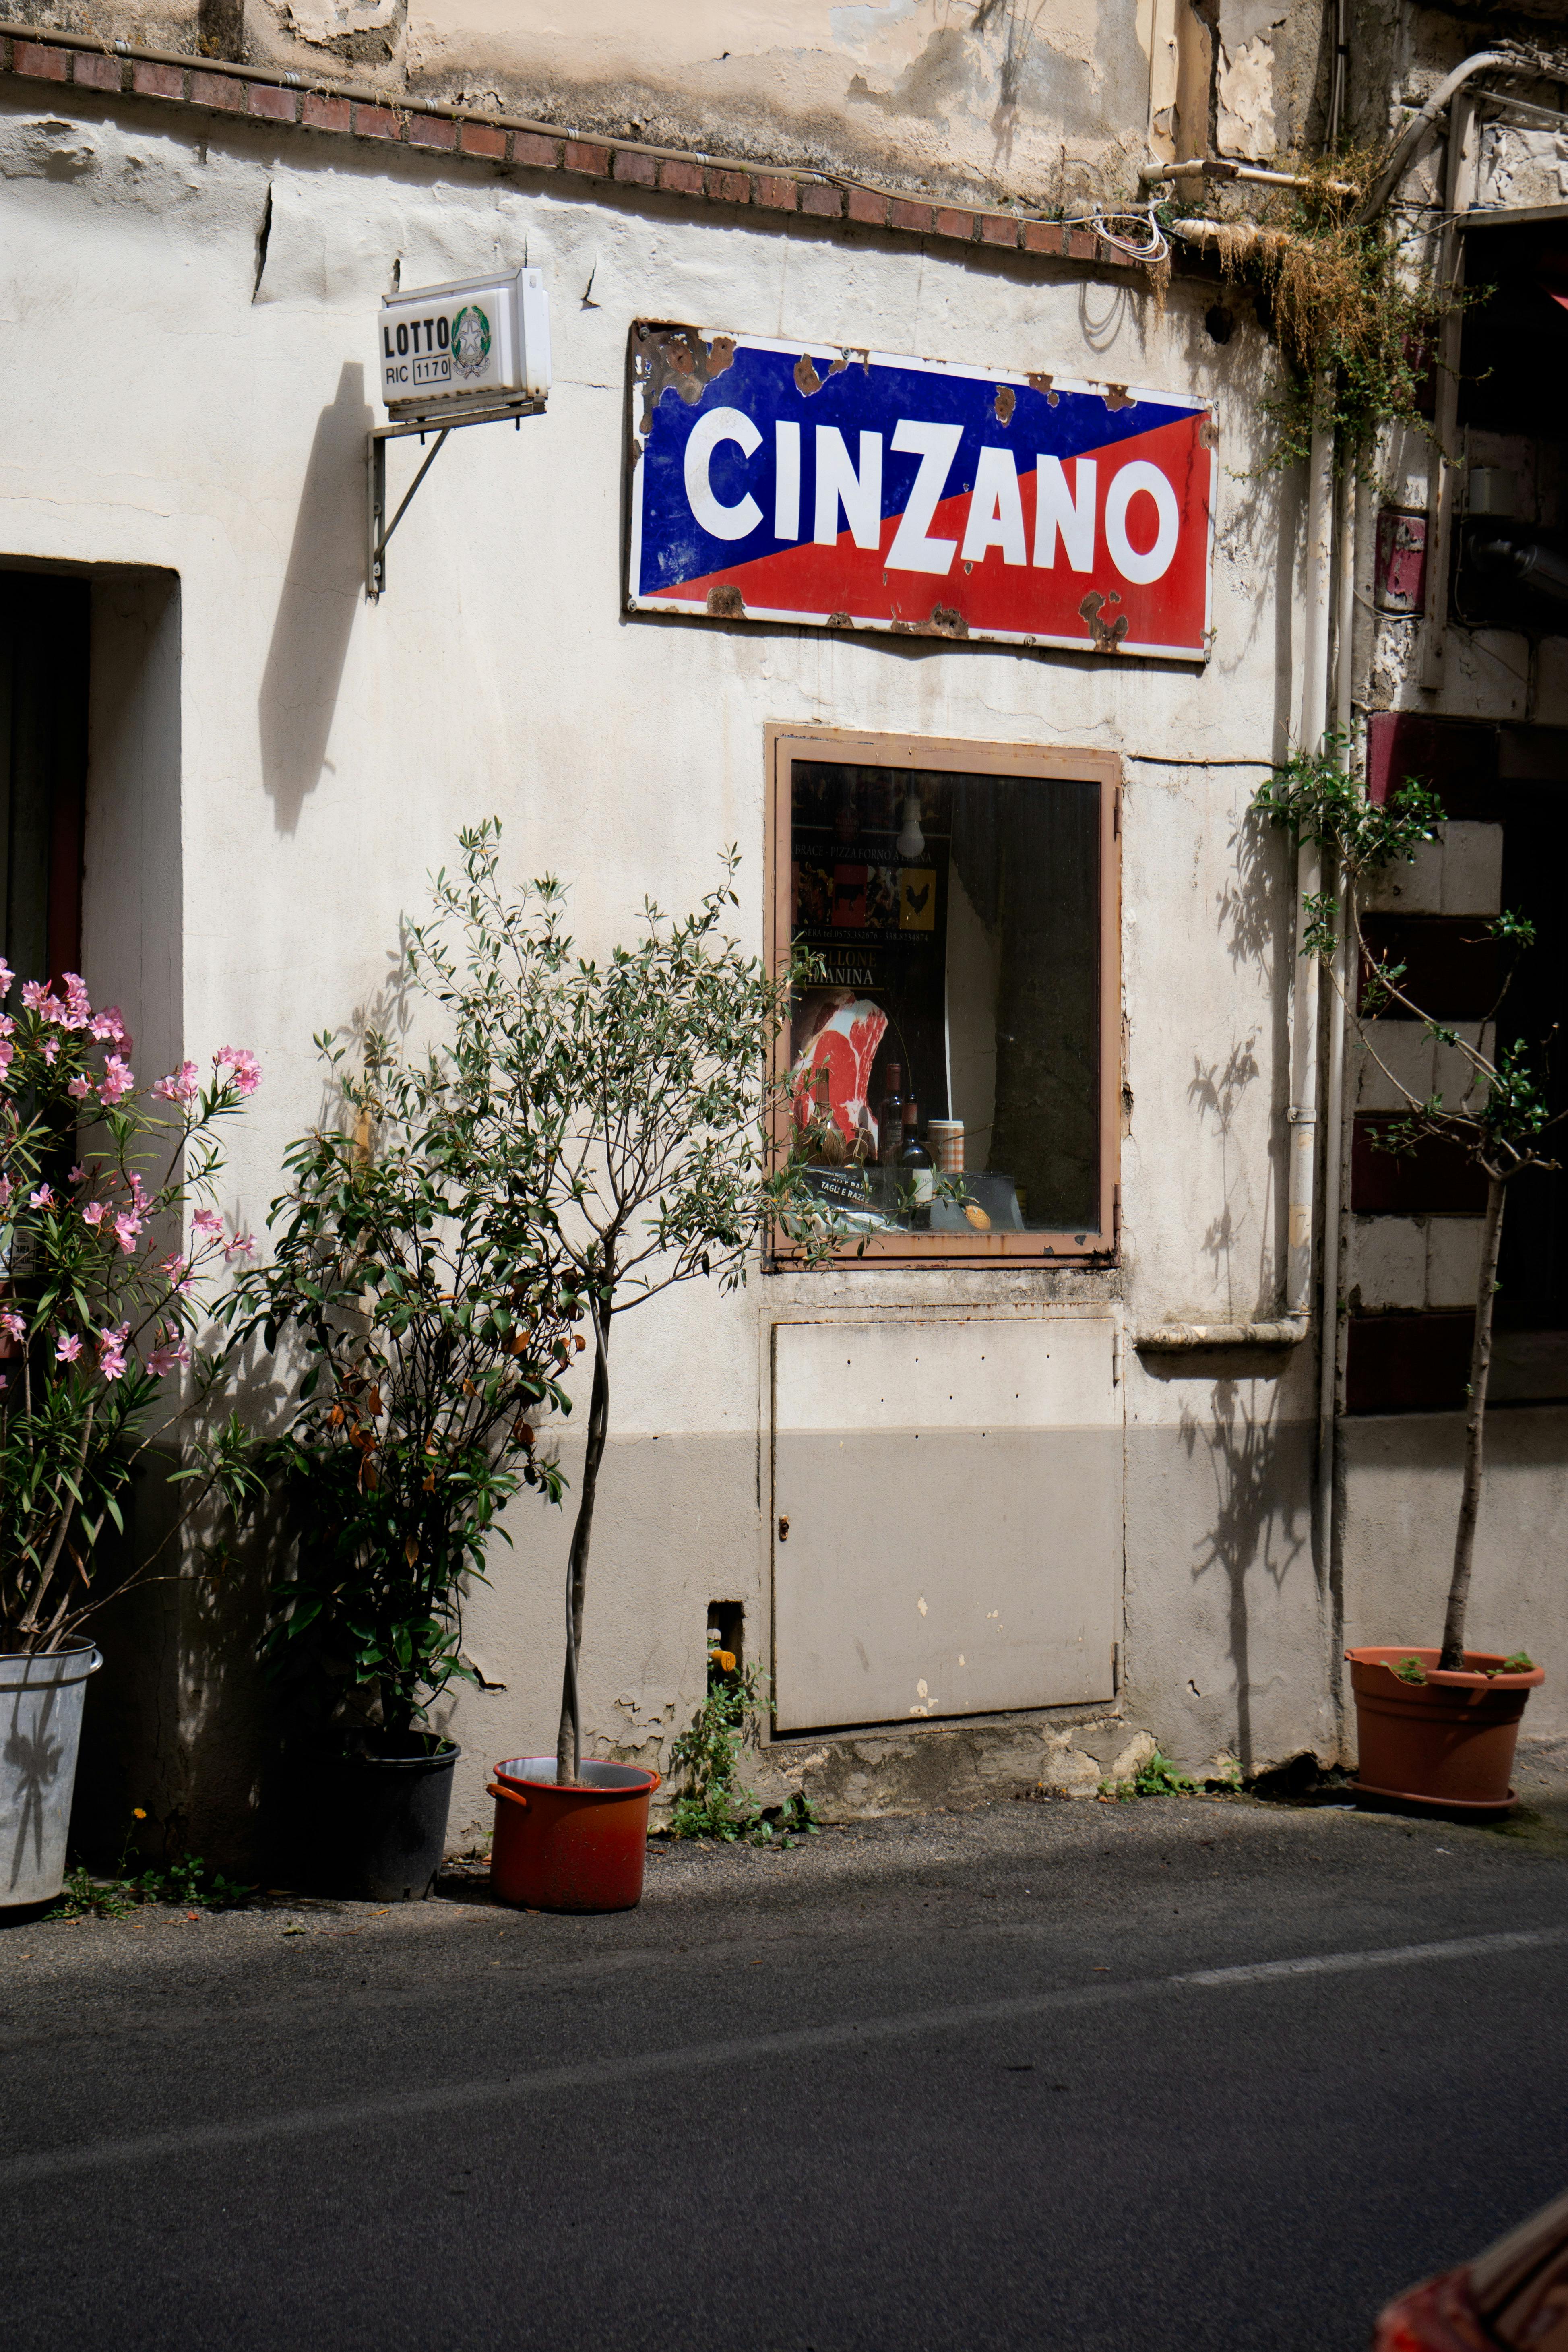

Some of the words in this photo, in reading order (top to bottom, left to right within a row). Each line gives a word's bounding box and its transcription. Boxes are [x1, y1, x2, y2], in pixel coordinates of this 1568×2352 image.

[383, 316, 450, 358] LOTTO
[385, 366, 409, 384] RIC
[416, 360, 448, 378] 1170
[684, 406, 1180, 585] CINZANO
[795, 844, 824, 856] BRACE
[830, 846, 856, 858] PIZZA
[858, 848, 891, 861] FORNO
[804, 928, 822, 937] SERA
[803, 967, 874, 985] HIANINA
[821, 1181, 840, 1194] TAGLI
[841, 1188, 846, 1196] E
